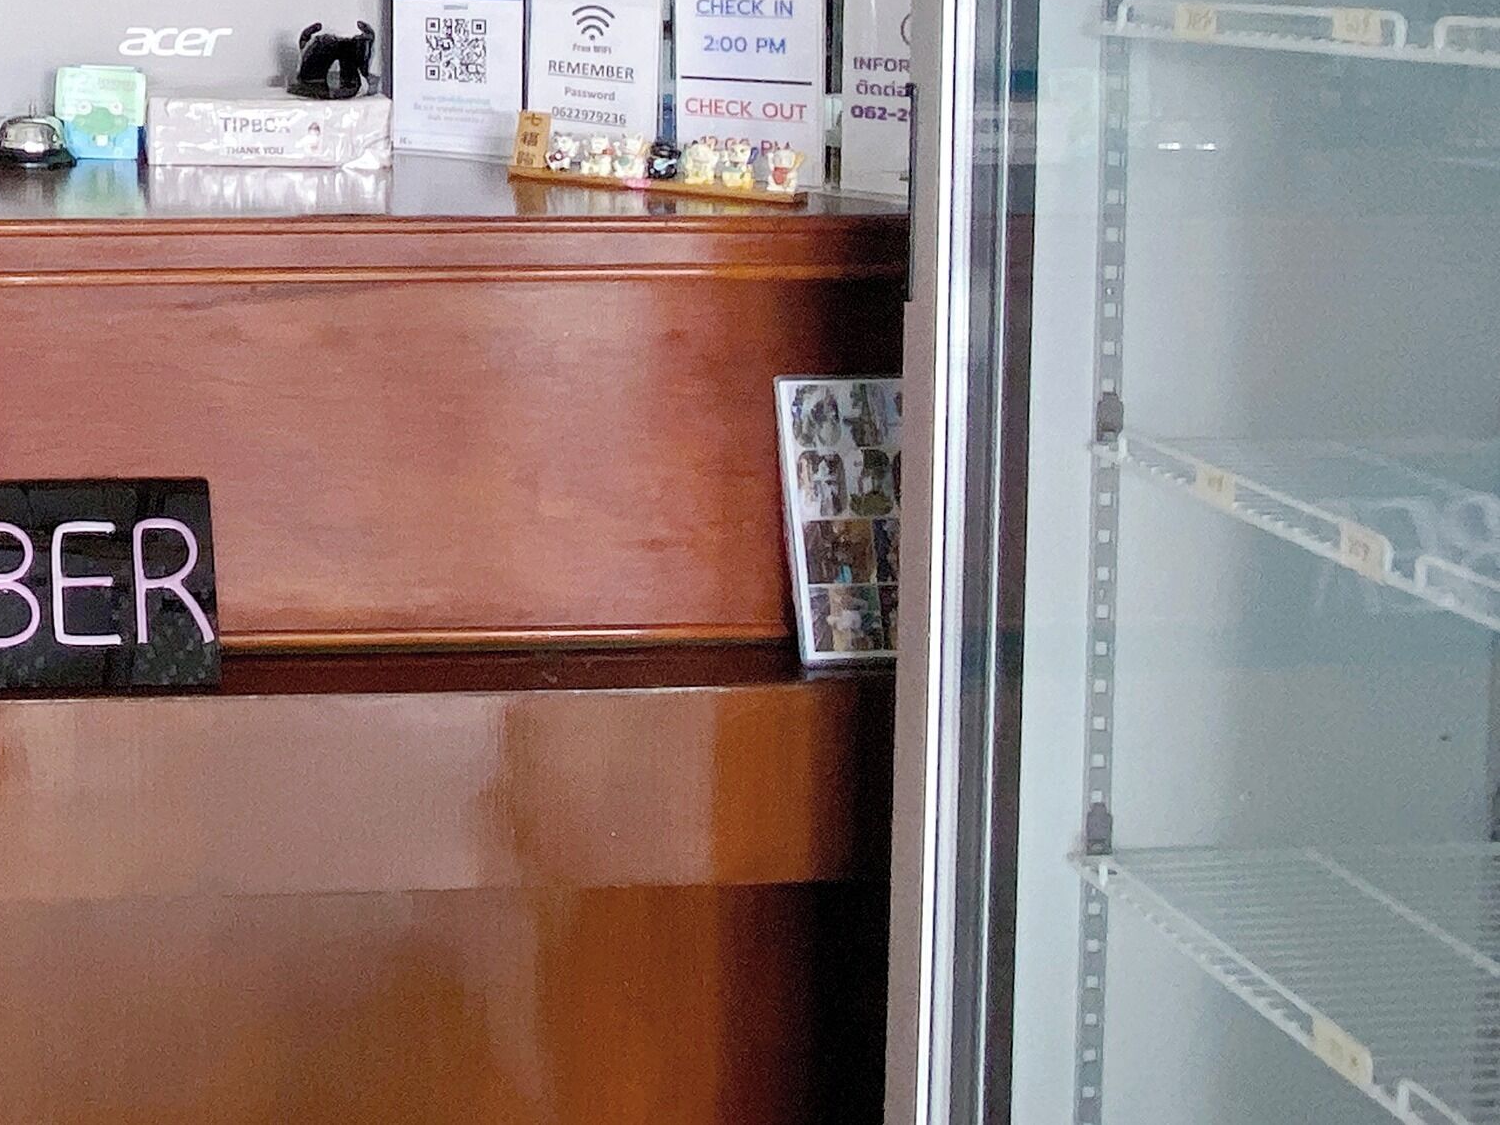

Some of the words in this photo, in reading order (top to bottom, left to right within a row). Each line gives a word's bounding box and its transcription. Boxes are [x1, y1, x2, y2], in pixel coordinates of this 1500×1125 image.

[773, 0, 794, 17] IN
[117, 25, 234, 58] acer
[703, 35, 749, 53] 2:00
[755, 36, 787, 55] PM
[547, 59, 635, 81] REMEMBER
[564, 86, 616, 101] Password
[684, 97, 752, 118] CHECK
[762, 102, 808, 121] OUT
[850, 104, 909, 122] 062-2
[219, 116, 292, 134] TIPBOX
[225, 145, 260, 155] THANK
[262, 146, 285, 156] YOU
